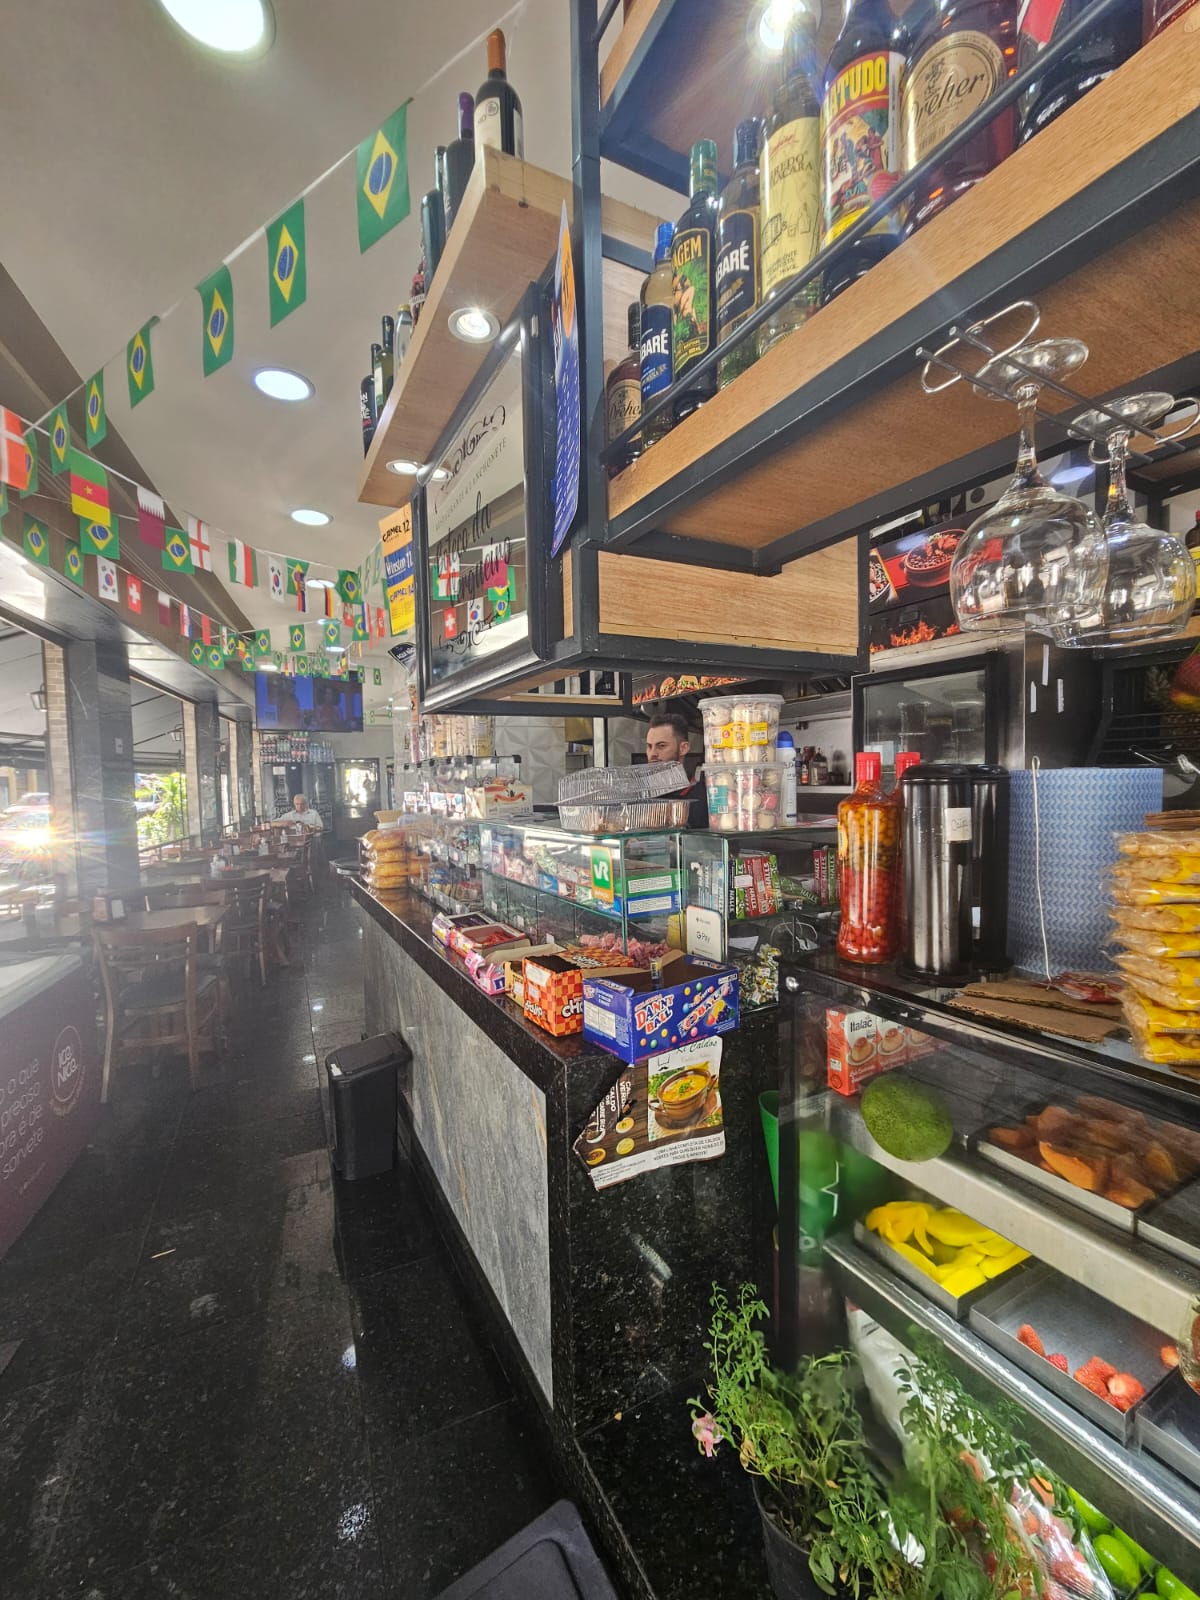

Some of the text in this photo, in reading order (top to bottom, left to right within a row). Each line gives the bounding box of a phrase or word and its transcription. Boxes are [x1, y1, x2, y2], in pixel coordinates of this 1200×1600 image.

[382, 519, 411, 542] CAMEL 12
[385, 558, 407, 575] Winston
[593, 860, 609, 882] VR
[850, 1018, 873, 1033] Italac
